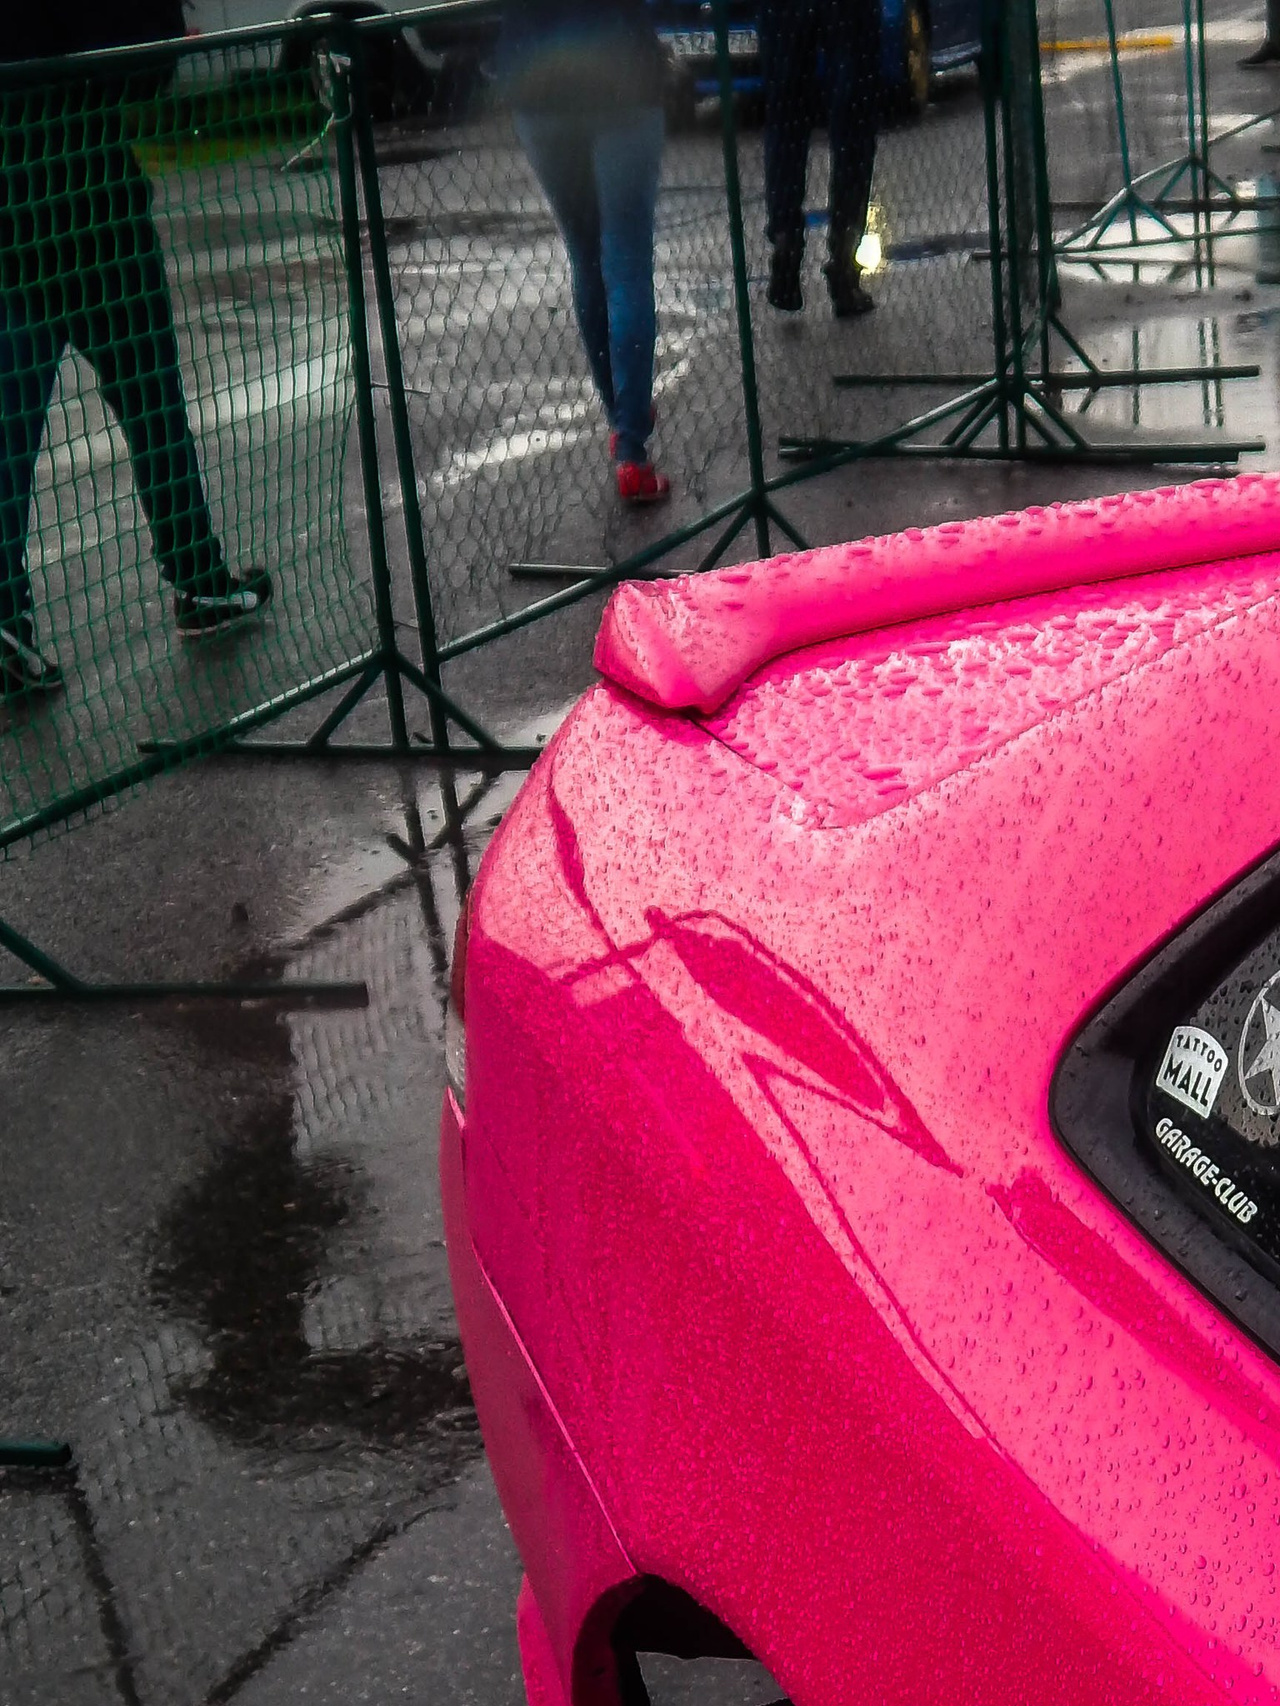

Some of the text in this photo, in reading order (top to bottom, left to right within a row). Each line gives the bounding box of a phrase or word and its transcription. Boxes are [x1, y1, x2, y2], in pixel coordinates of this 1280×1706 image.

[1176, 1034, 1223, 1073] TATTOO
[1163, 1054, 1212, 1107] MALL
[1155, 1117, 1258, 1224] GARAGE-CLUB
